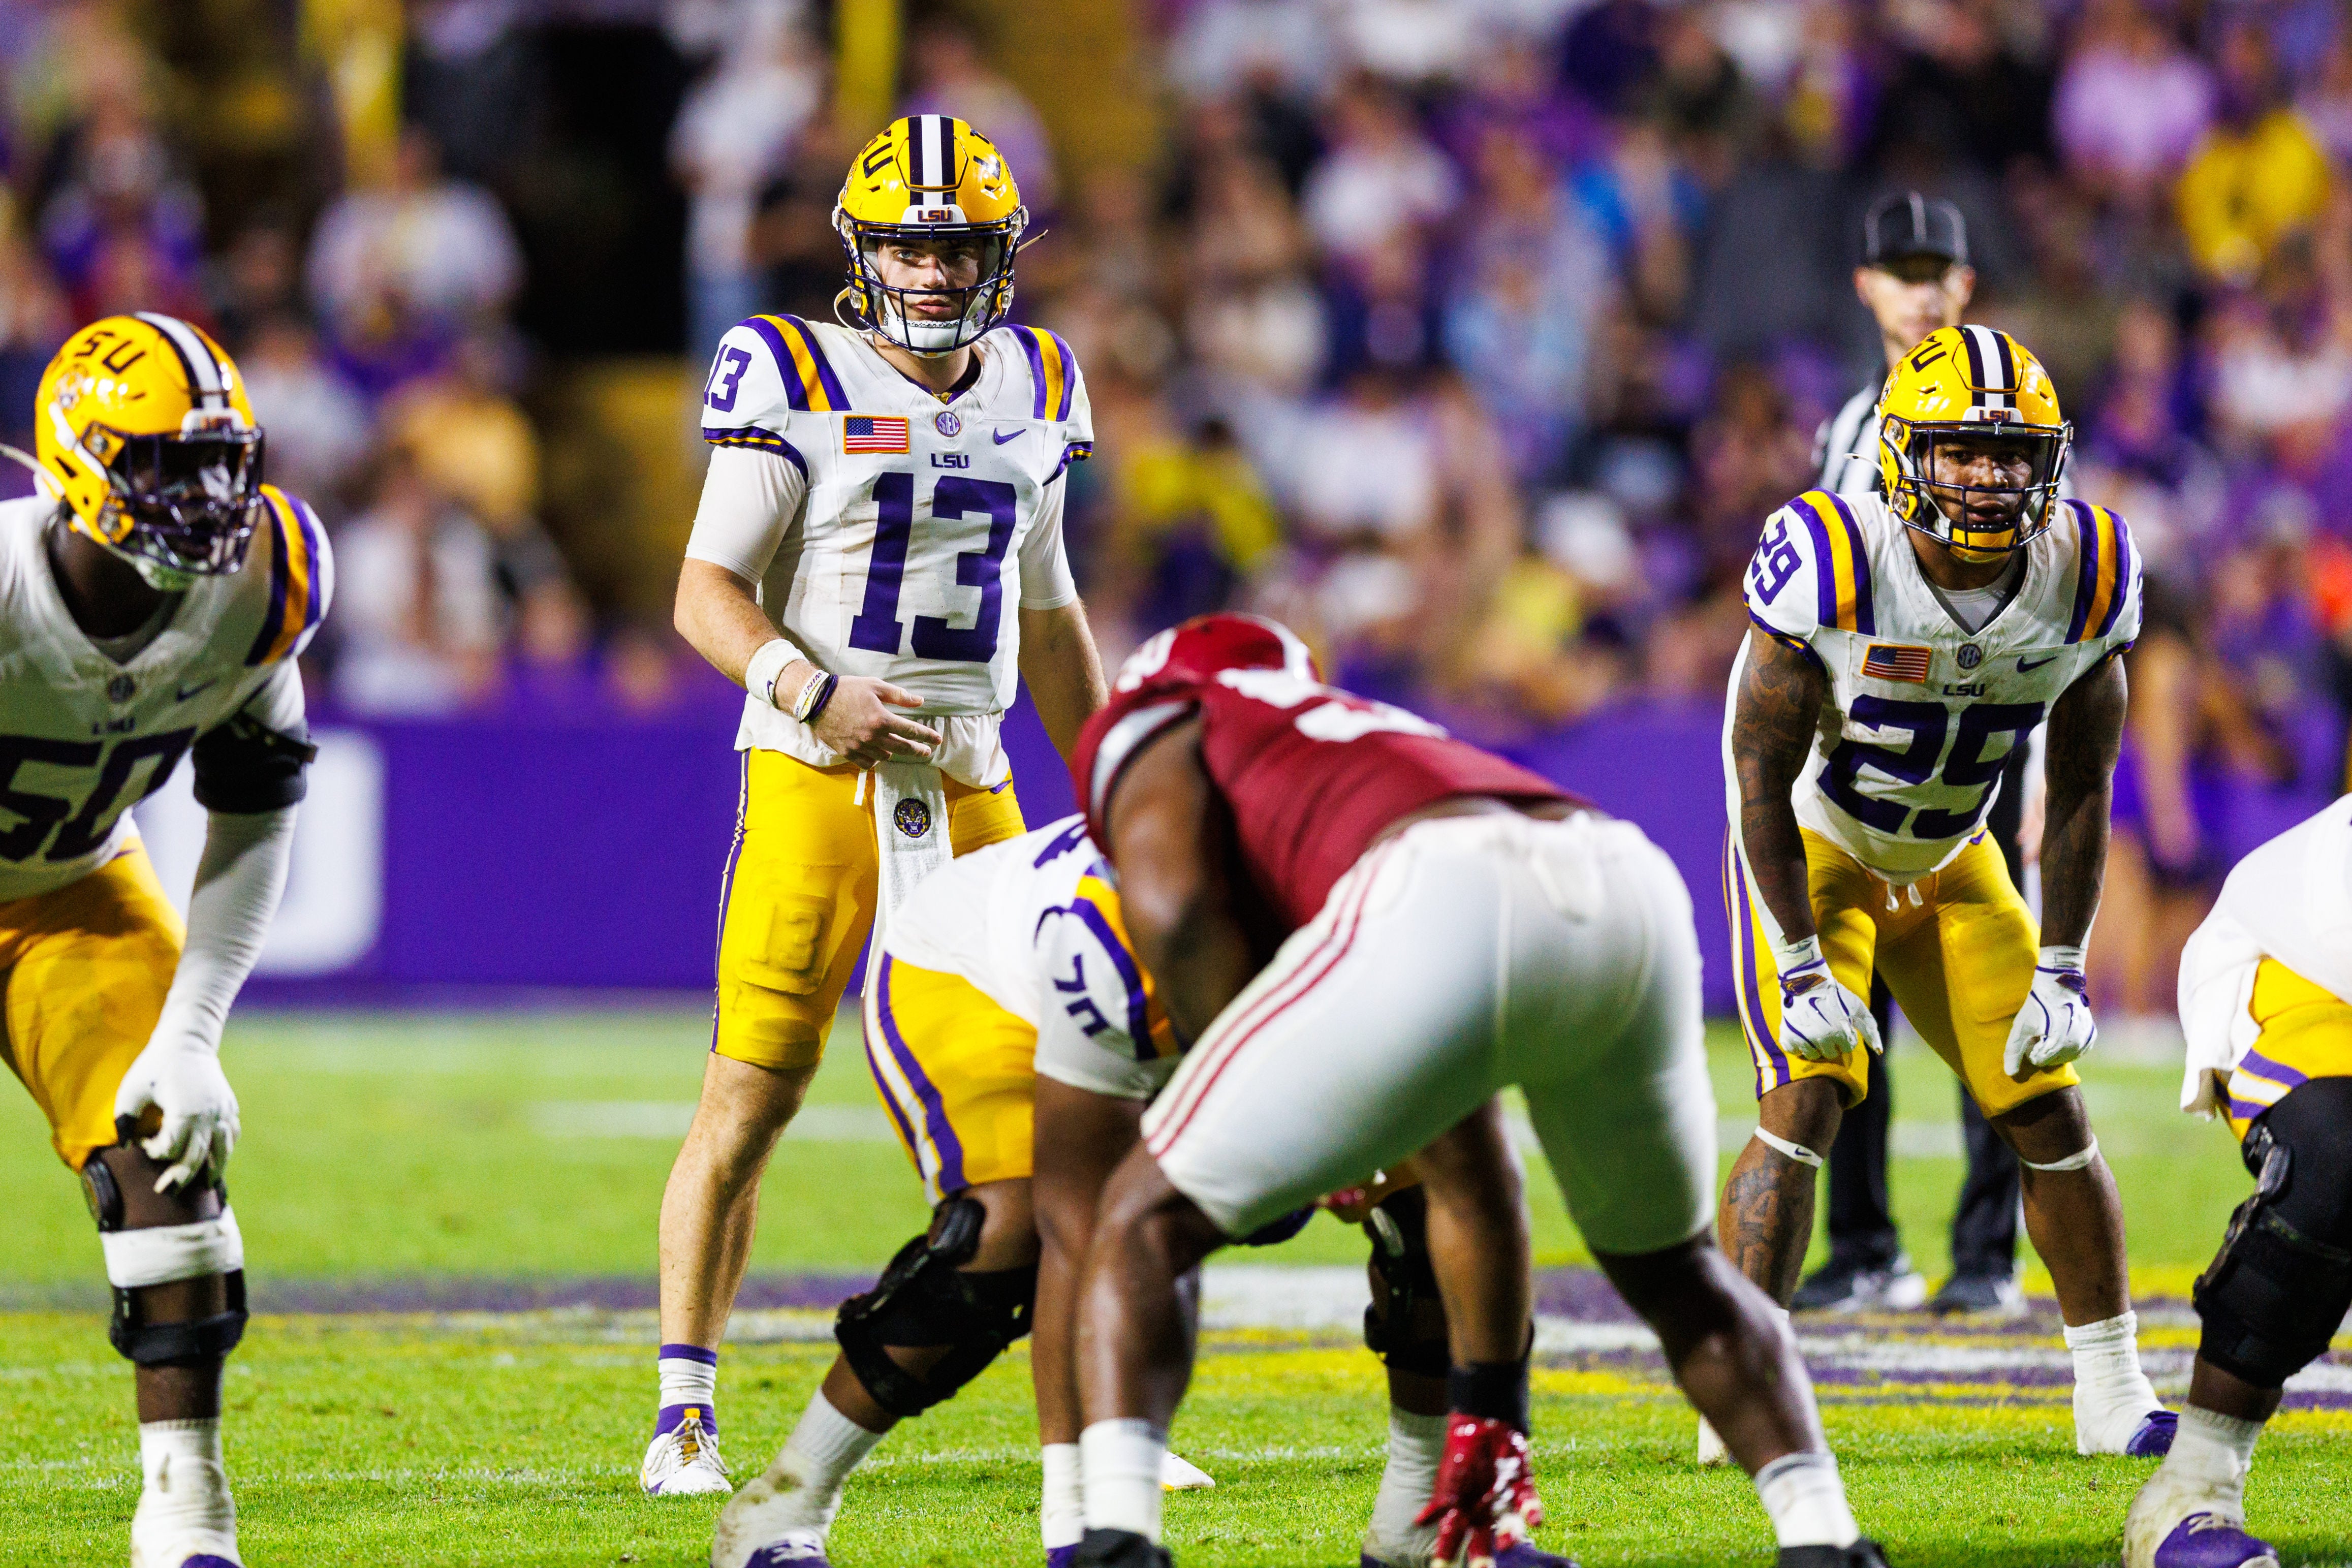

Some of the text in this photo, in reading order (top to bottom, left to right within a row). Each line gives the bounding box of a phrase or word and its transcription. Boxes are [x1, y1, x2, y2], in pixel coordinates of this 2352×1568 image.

[918, 210, 952, 222] LSU
[704, 344, 751, 413] 13
[936, 412, 960, 435] SEC
[1979, 410, 2011, 422] LSU
[931, 453, 970, 468] LSU
[848, 472, 1017, 663] 13
[1752, 515, 1802, 606] 29
[1942, 683, 1985, 697] LSU
[1817, 694, 2046, 839] 29
